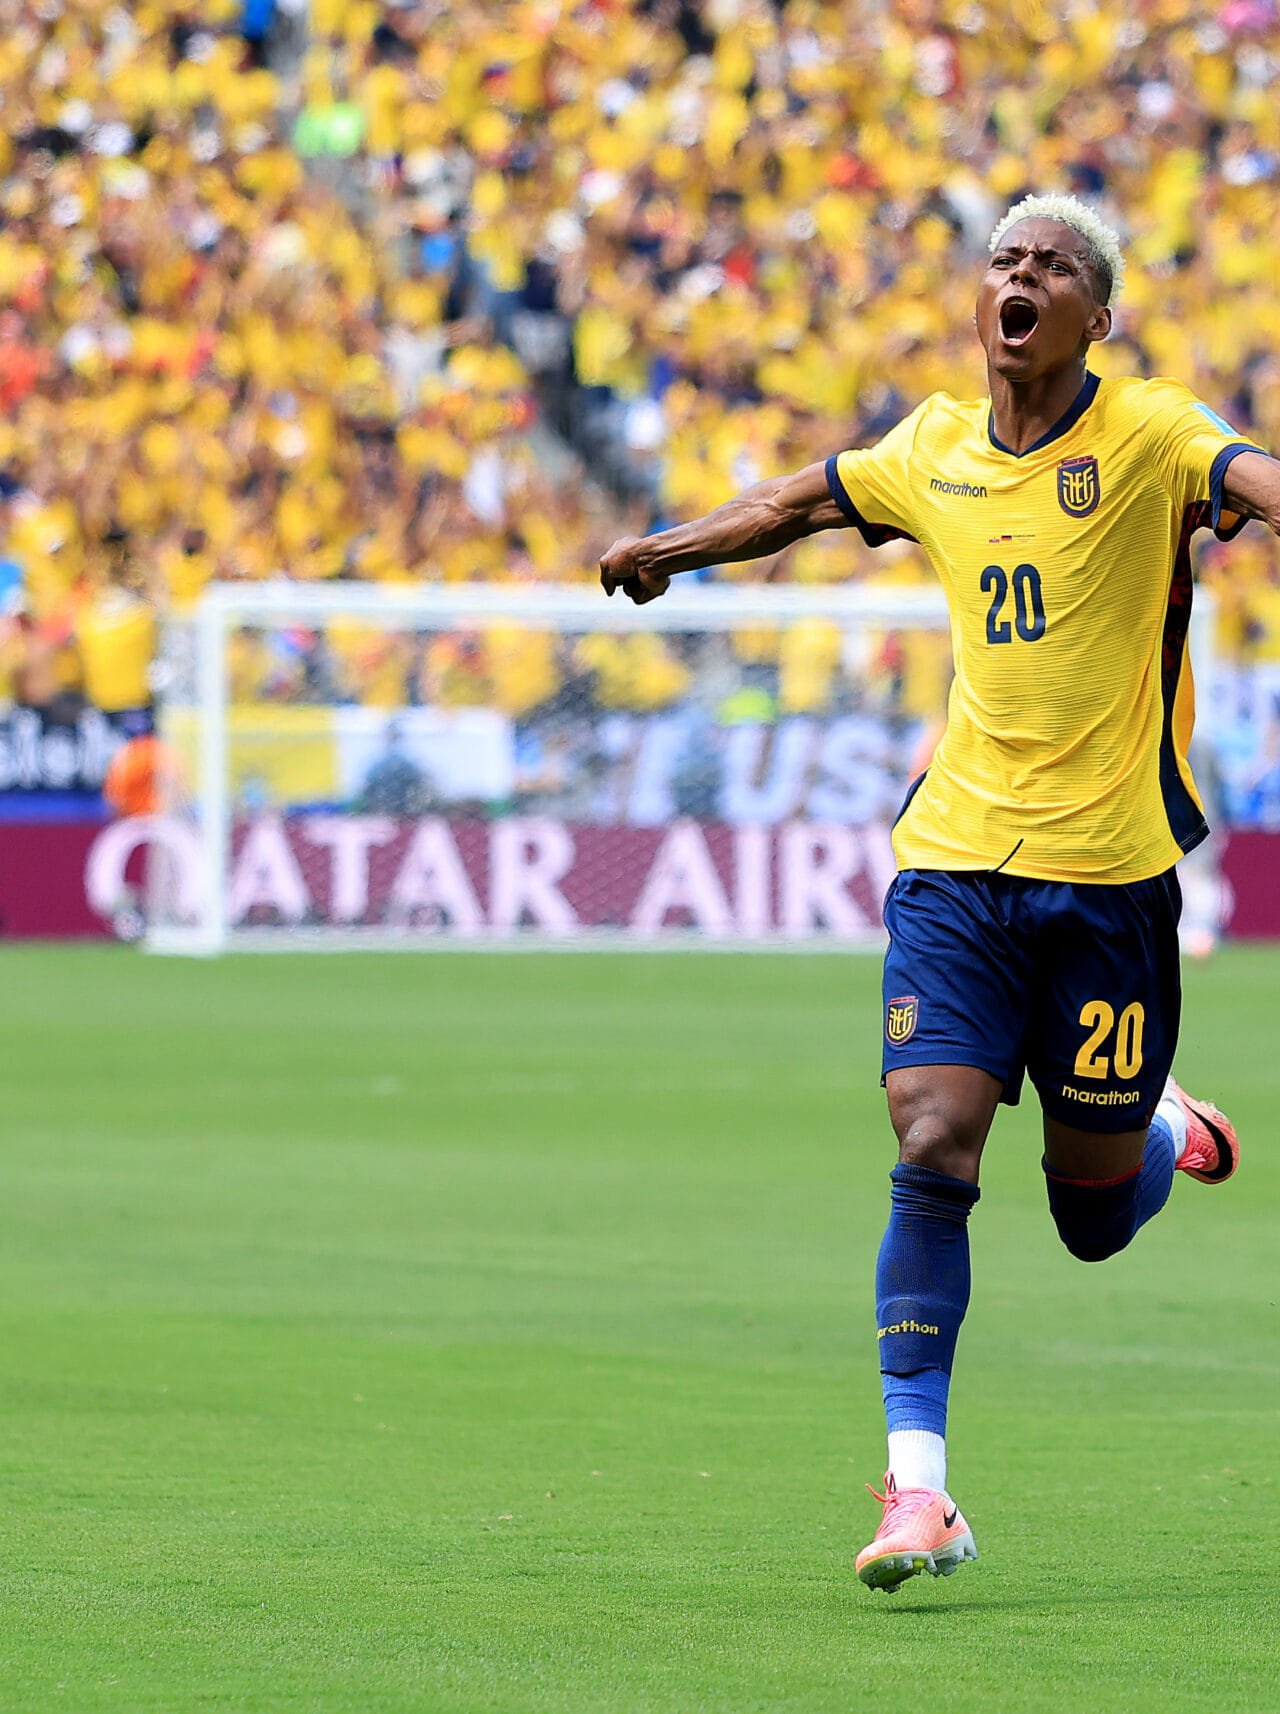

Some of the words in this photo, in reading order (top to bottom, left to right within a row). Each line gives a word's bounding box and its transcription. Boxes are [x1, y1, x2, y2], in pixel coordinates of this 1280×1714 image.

[930, 478, 988, 498] marathon
[980, 564, 1046, 644] 20
[84, 813, 582, 932] QATAR
[628, 813, 900, 936] AIR
[1074, 1000, 1145, 1079] 20
[1062, 1085, 1140, 1105] marathon
[877, 1319, 940, 1340] arathon
